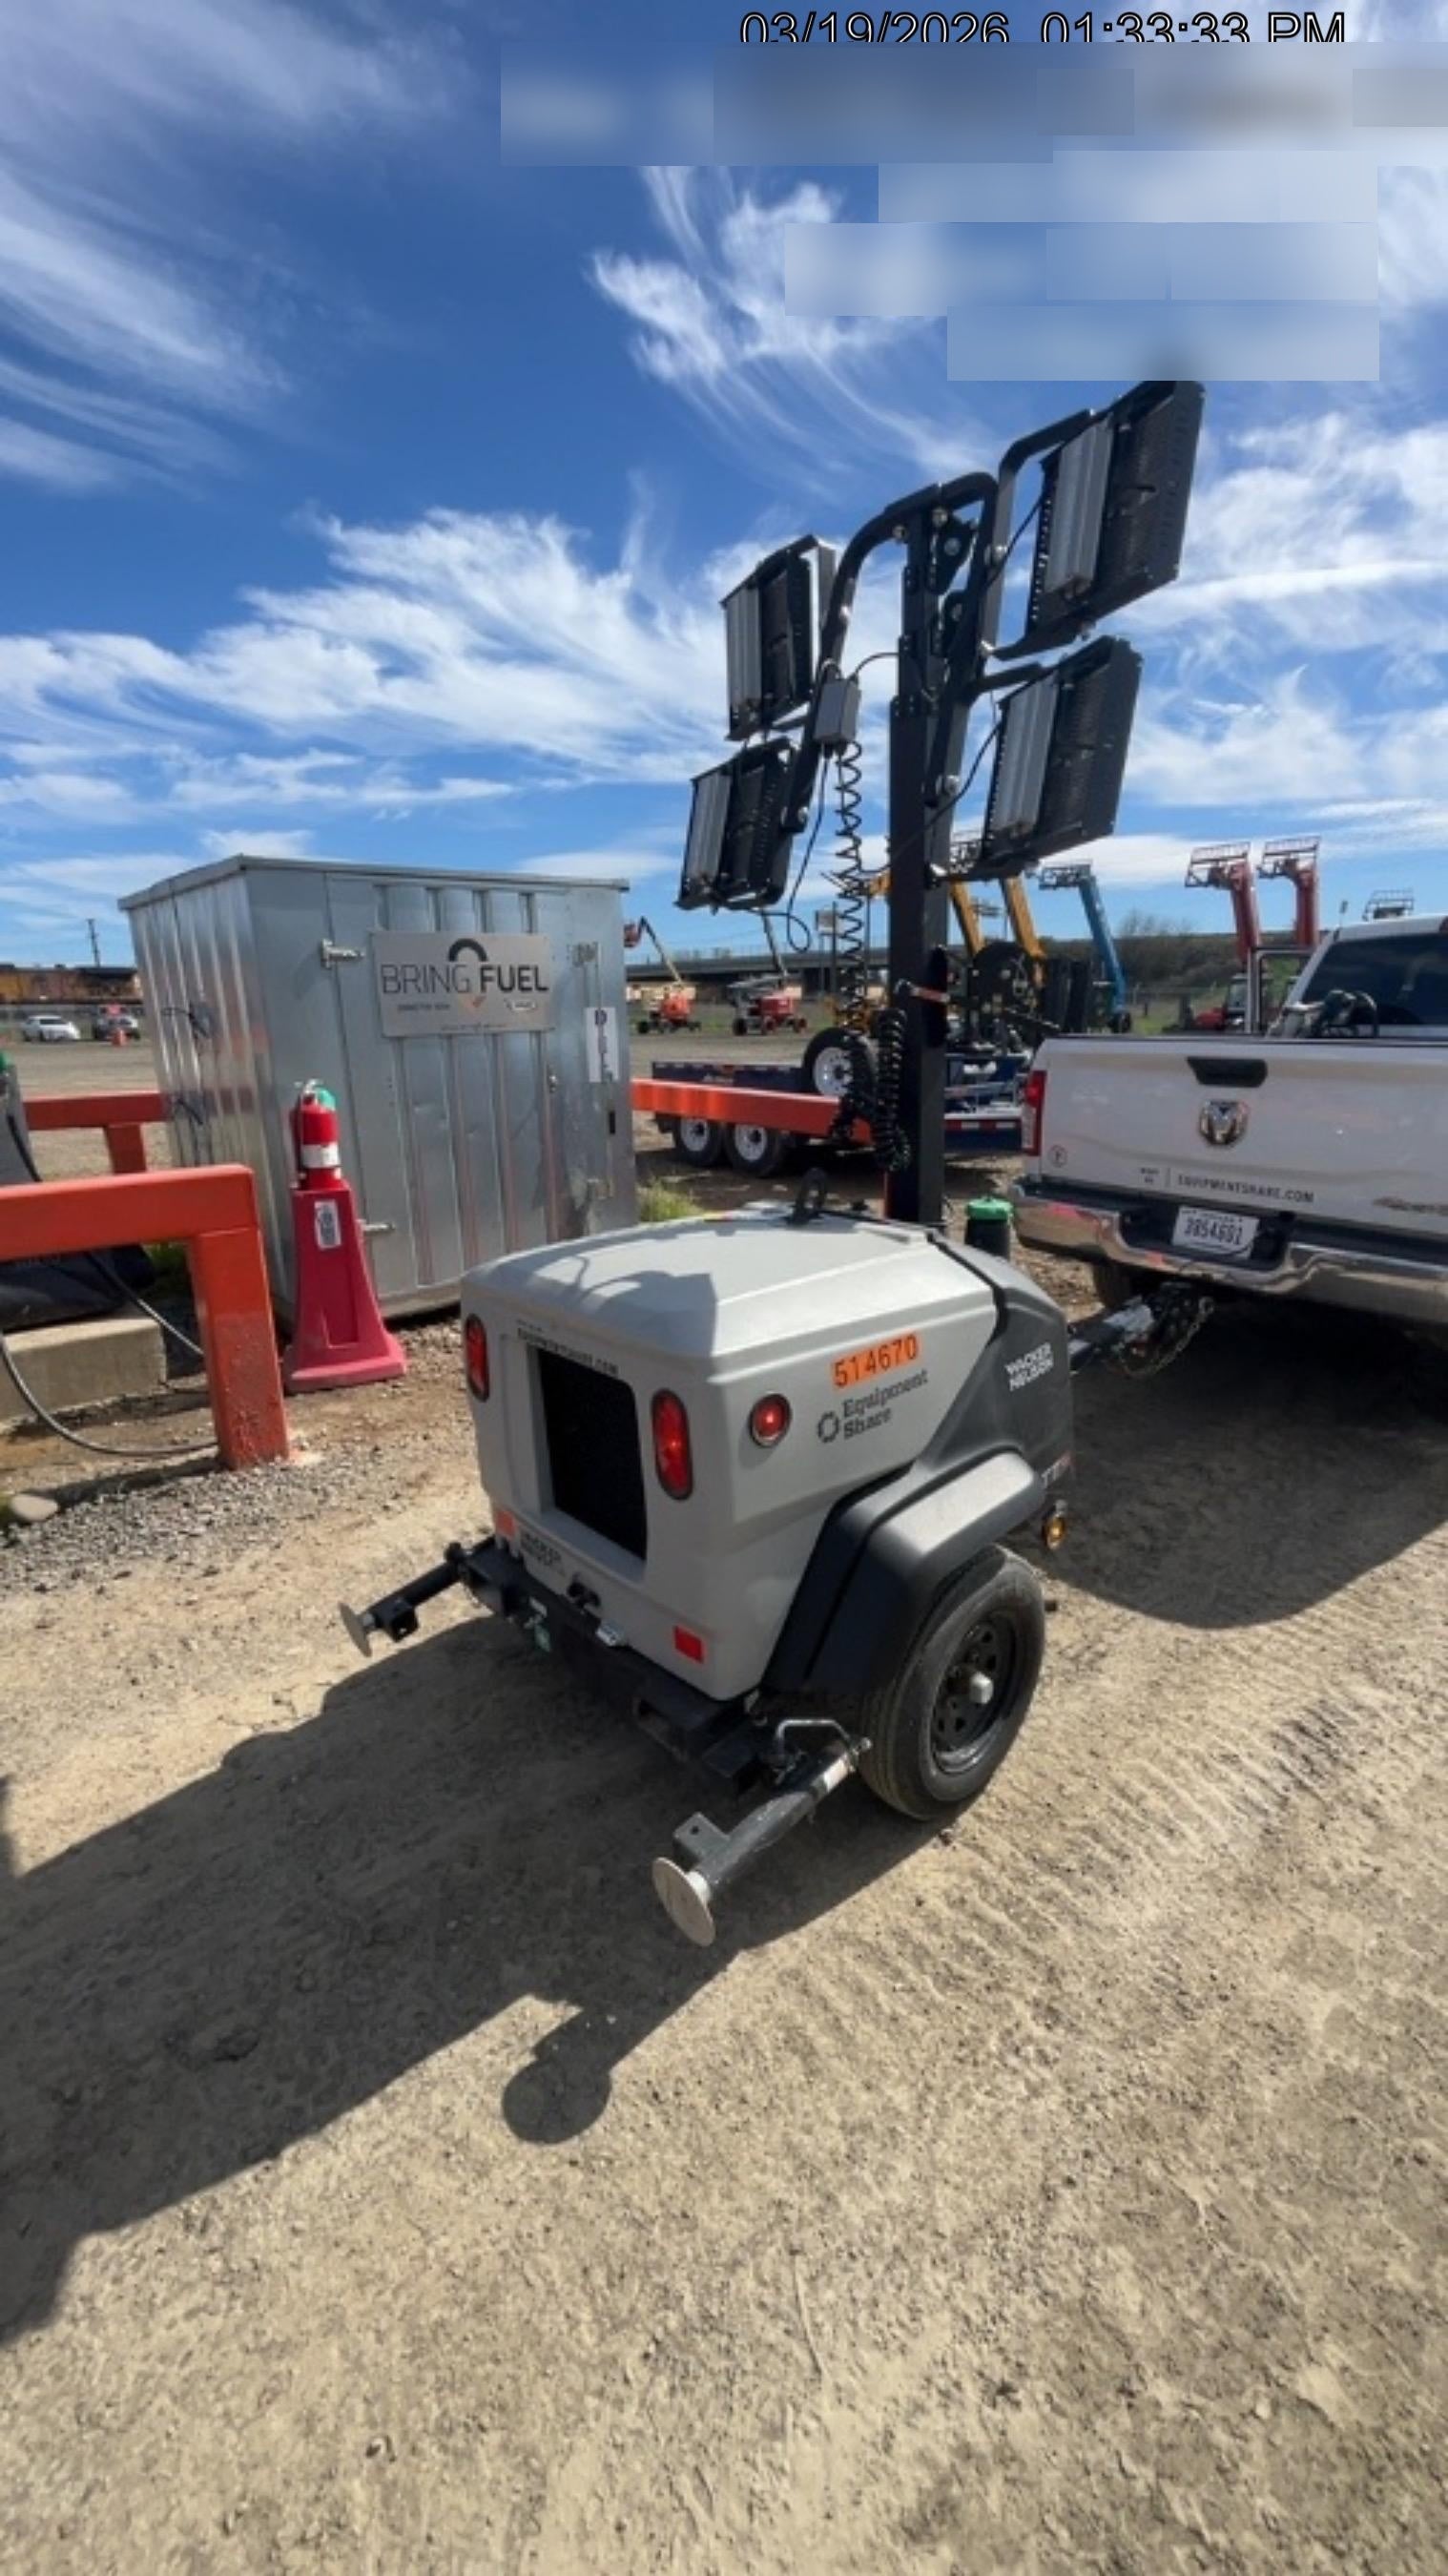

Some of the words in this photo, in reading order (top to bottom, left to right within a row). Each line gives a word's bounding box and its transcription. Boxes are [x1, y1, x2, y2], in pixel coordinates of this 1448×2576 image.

[382, 964, 473, 994] BRING
[480, 964, 550, 994] FUEL
[834, 1334, 919, 1389] 514670
[843, 1368, 928, 1418] Equipment
[843, 1407, 891, 1440] Share
